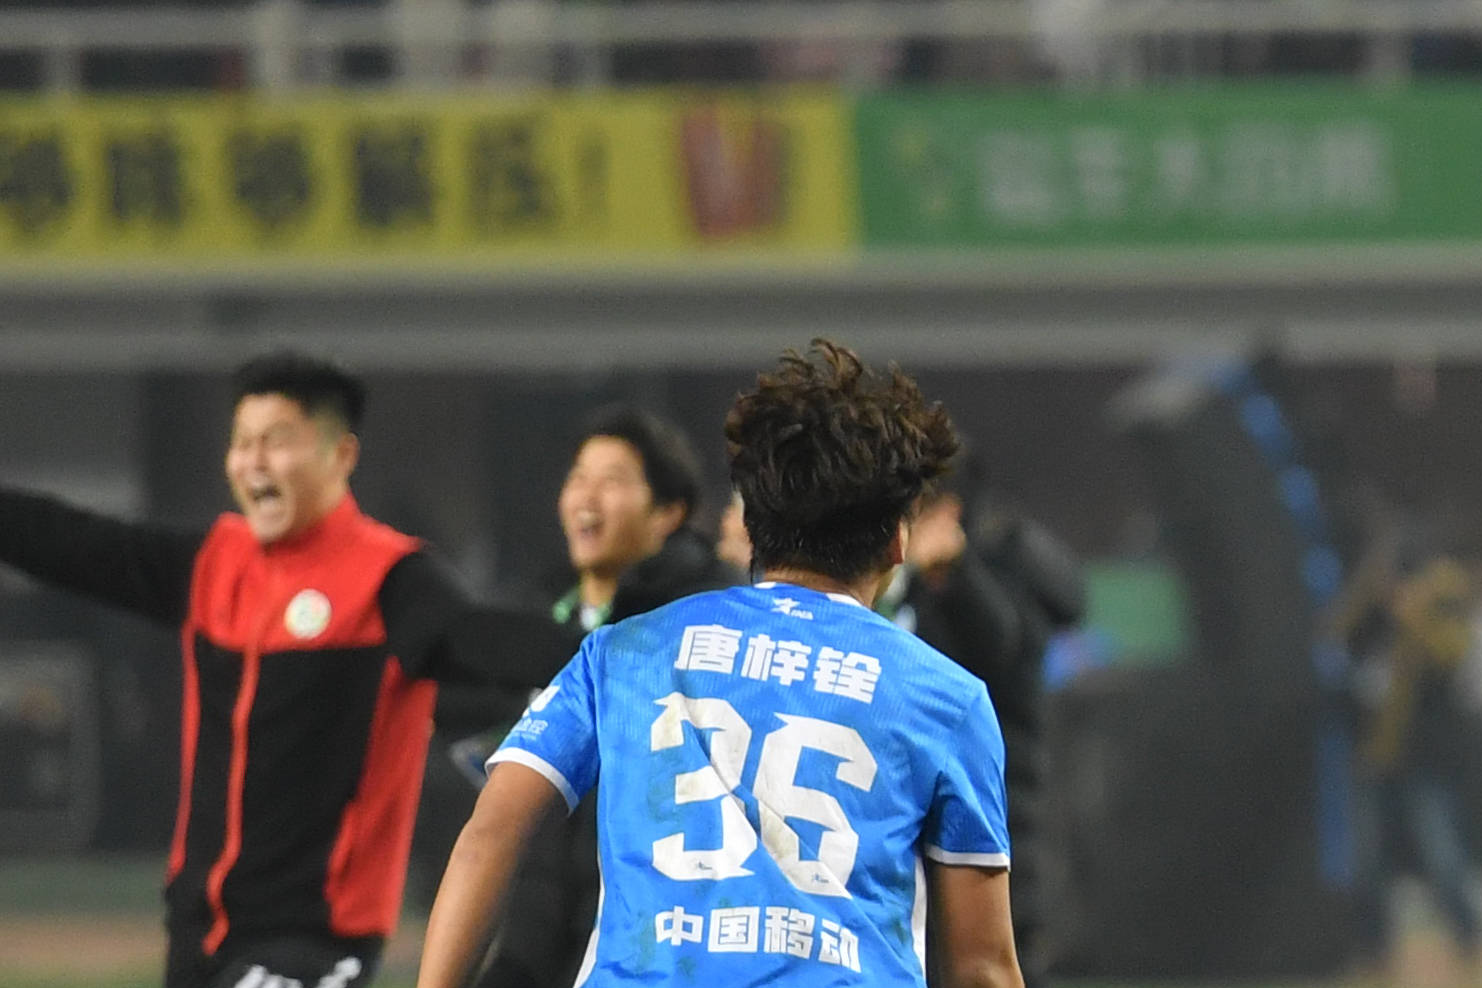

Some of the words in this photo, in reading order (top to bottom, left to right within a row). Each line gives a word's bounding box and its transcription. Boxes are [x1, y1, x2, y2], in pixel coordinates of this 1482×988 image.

[673, 624, 882, 704] 唐梓铨
[650, 691, 878, 899] 36
[655, 905, 862, 973] 中国移动
